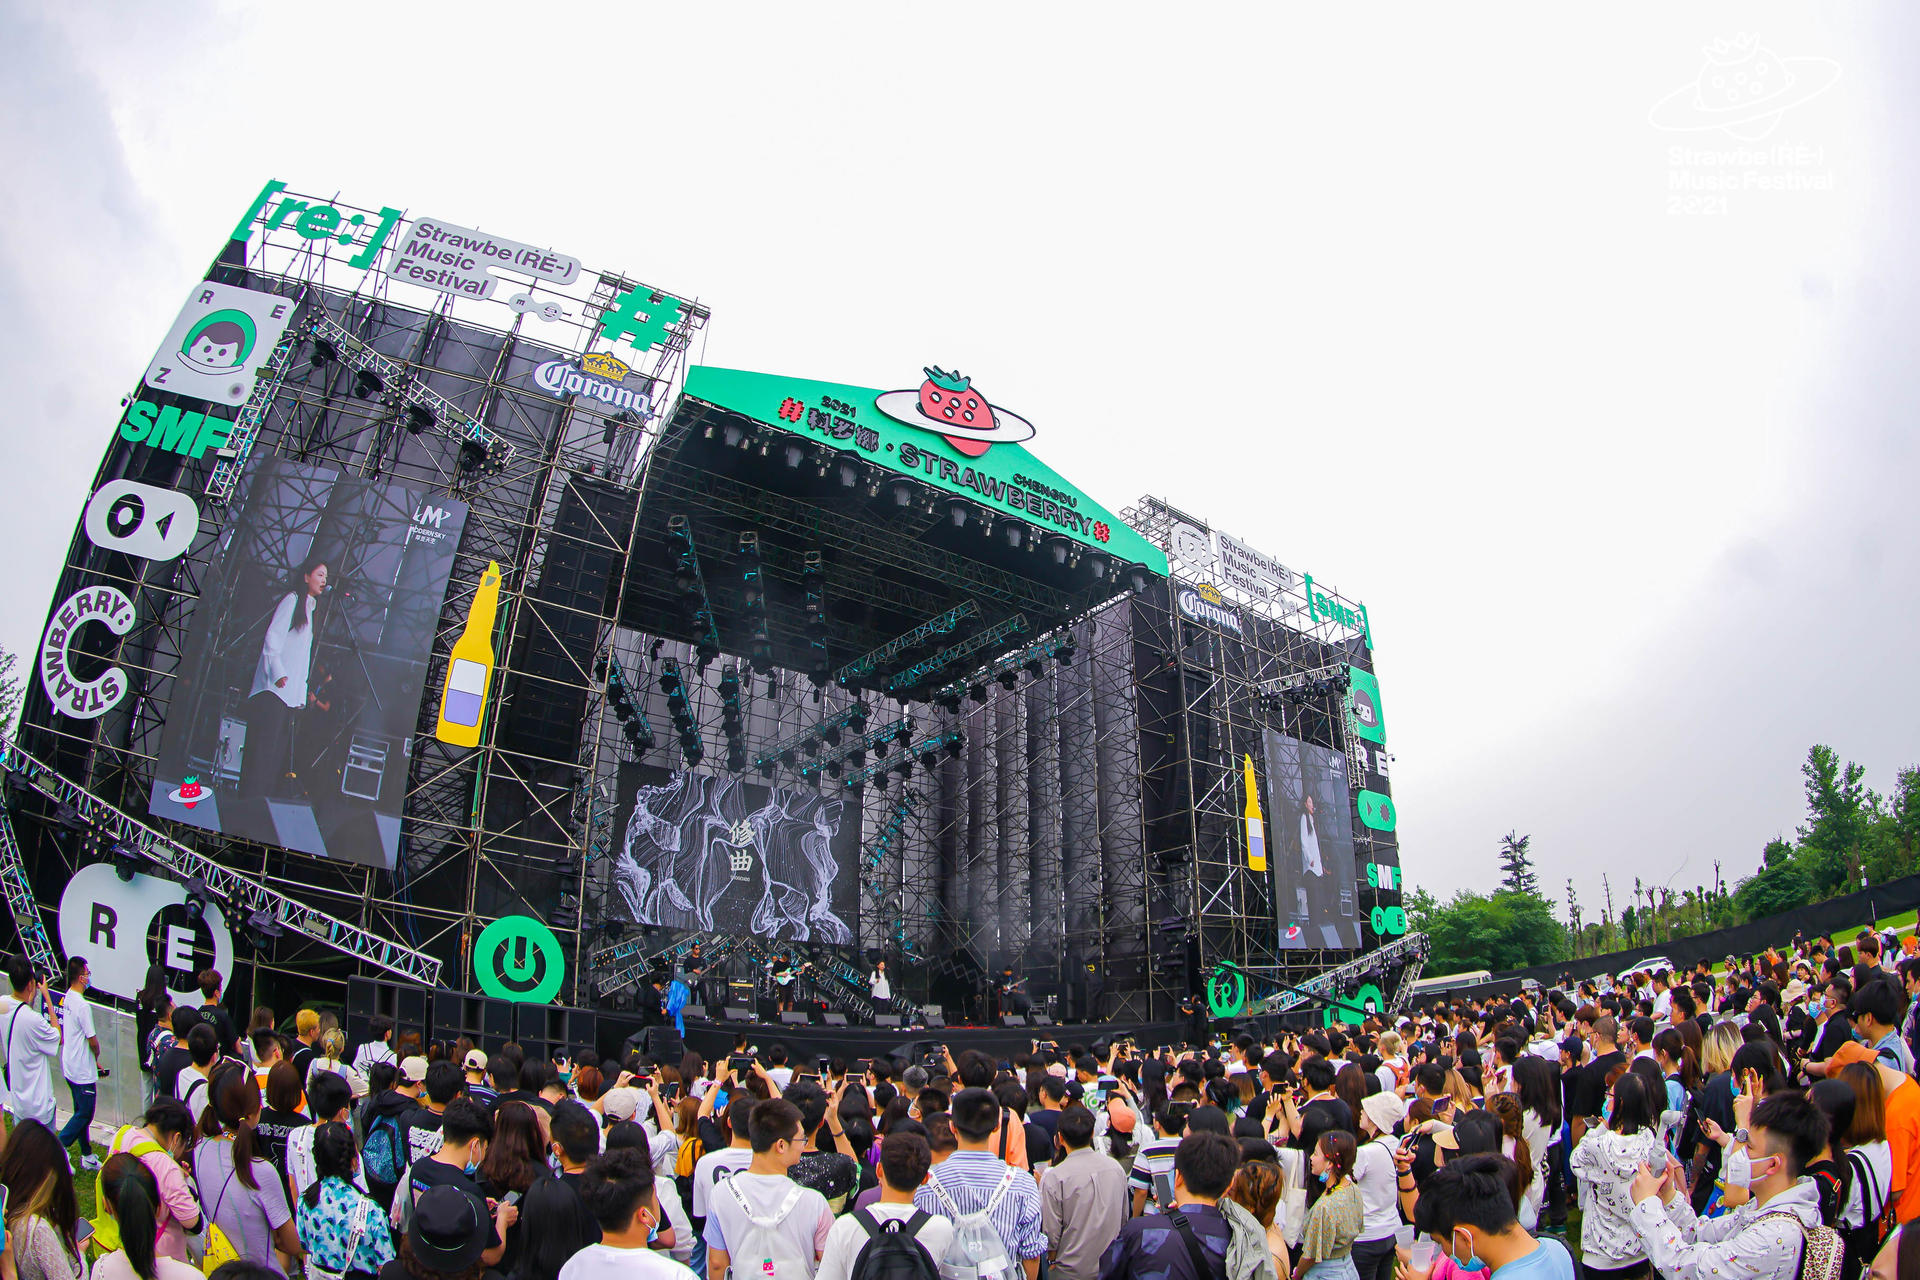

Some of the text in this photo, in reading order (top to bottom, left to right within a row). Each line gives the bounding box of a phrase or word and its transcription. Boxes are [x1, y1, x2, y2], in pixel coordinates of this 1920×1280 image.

[404, 239, 476, 271] Music
[393, 257, 489, 296] Festival
[533, 359, 654, 420] Corona
[821, 395, 857, 418] 2021
[119, 400, 236, 460] SMF
[1013, 473, 1078, 509] CHENGDU
[1222, 550, 1257, 579] Music
[1224, 567, 1269, 599] Festival
[1178, 589, 1243, 635] Corona
[1366, 862, 1402, 891] SMF
[90, 902, 196, 973] R E
